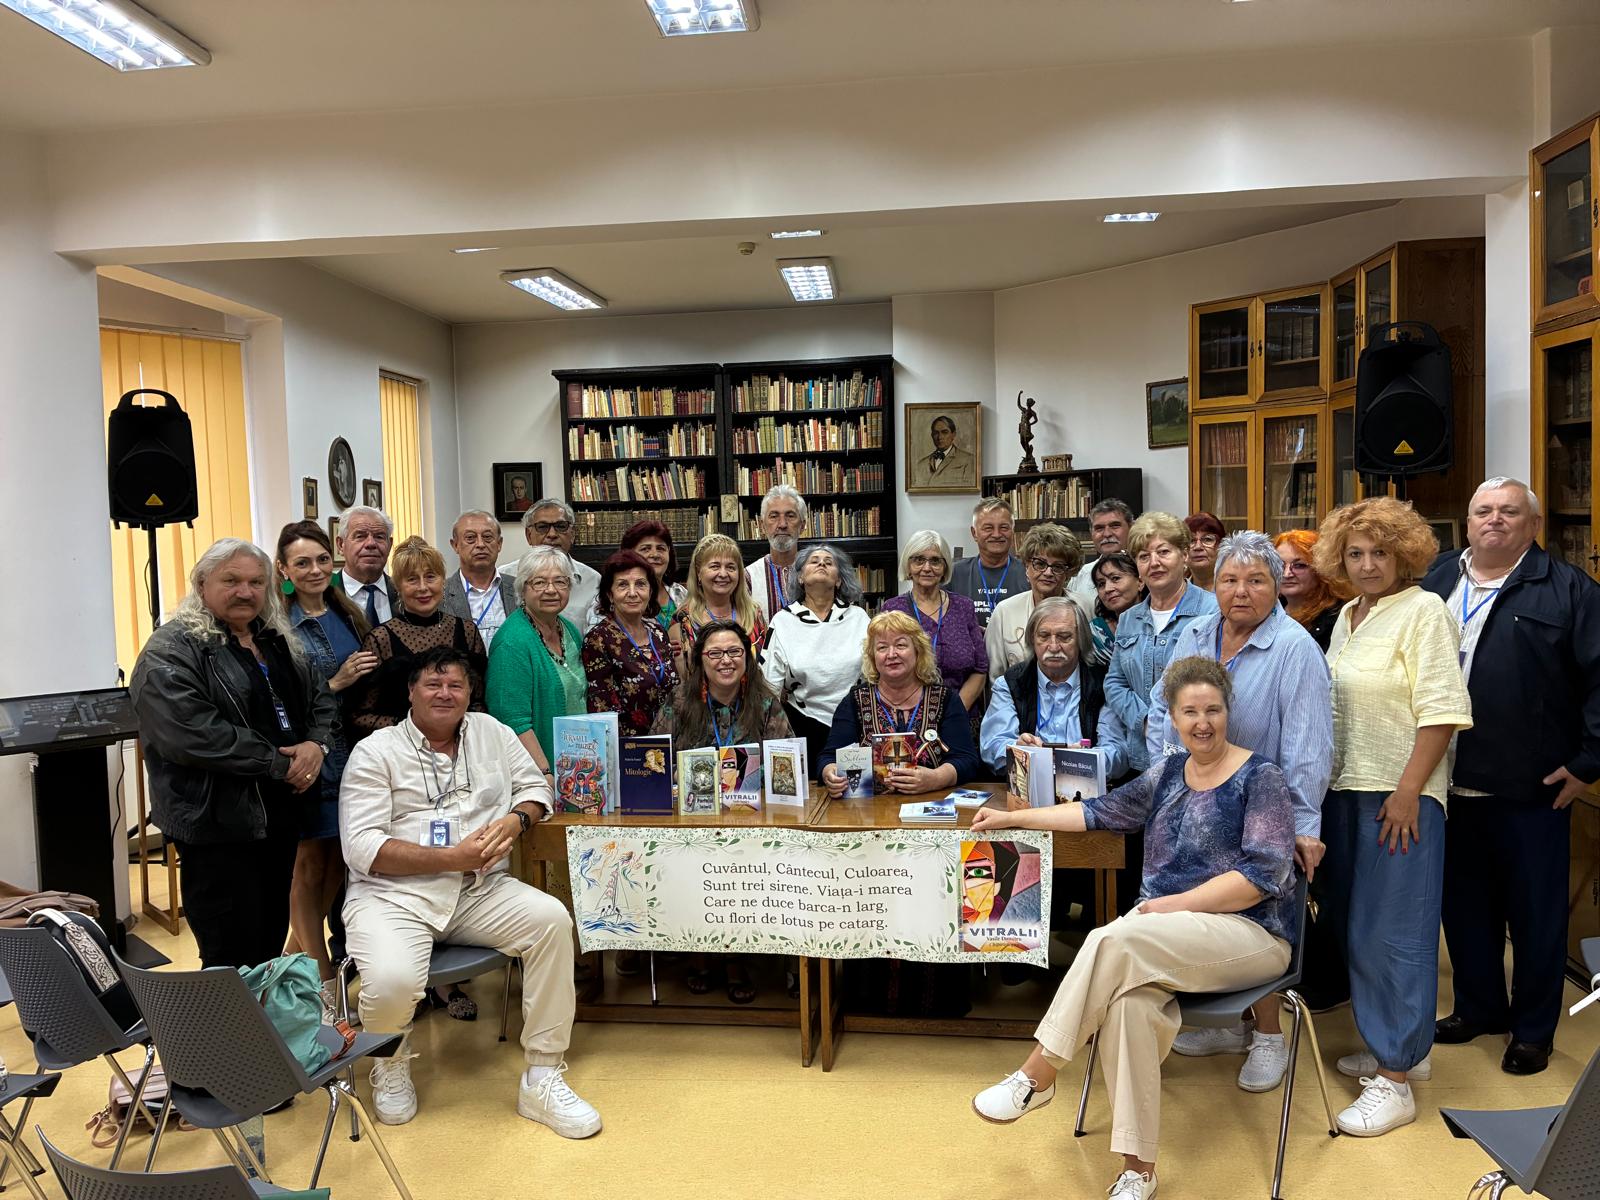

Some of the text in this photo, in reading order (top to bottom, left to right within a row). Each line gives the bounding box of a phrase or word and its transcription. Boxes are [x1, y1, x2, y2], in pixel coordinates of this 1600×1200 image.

[702, 862, 913, 882] Cuvântul, Cântecul, Culoarea,
[703, 879, 912, 899] Sunt trei sirene. Viața-i marea
[703, 896, 888, 914] Care ne duce barca-n larg,
[704, 912, 888, 931] Cu flori de lotus pe catarg.
[969, 927, 1038, 938] VITRALII
